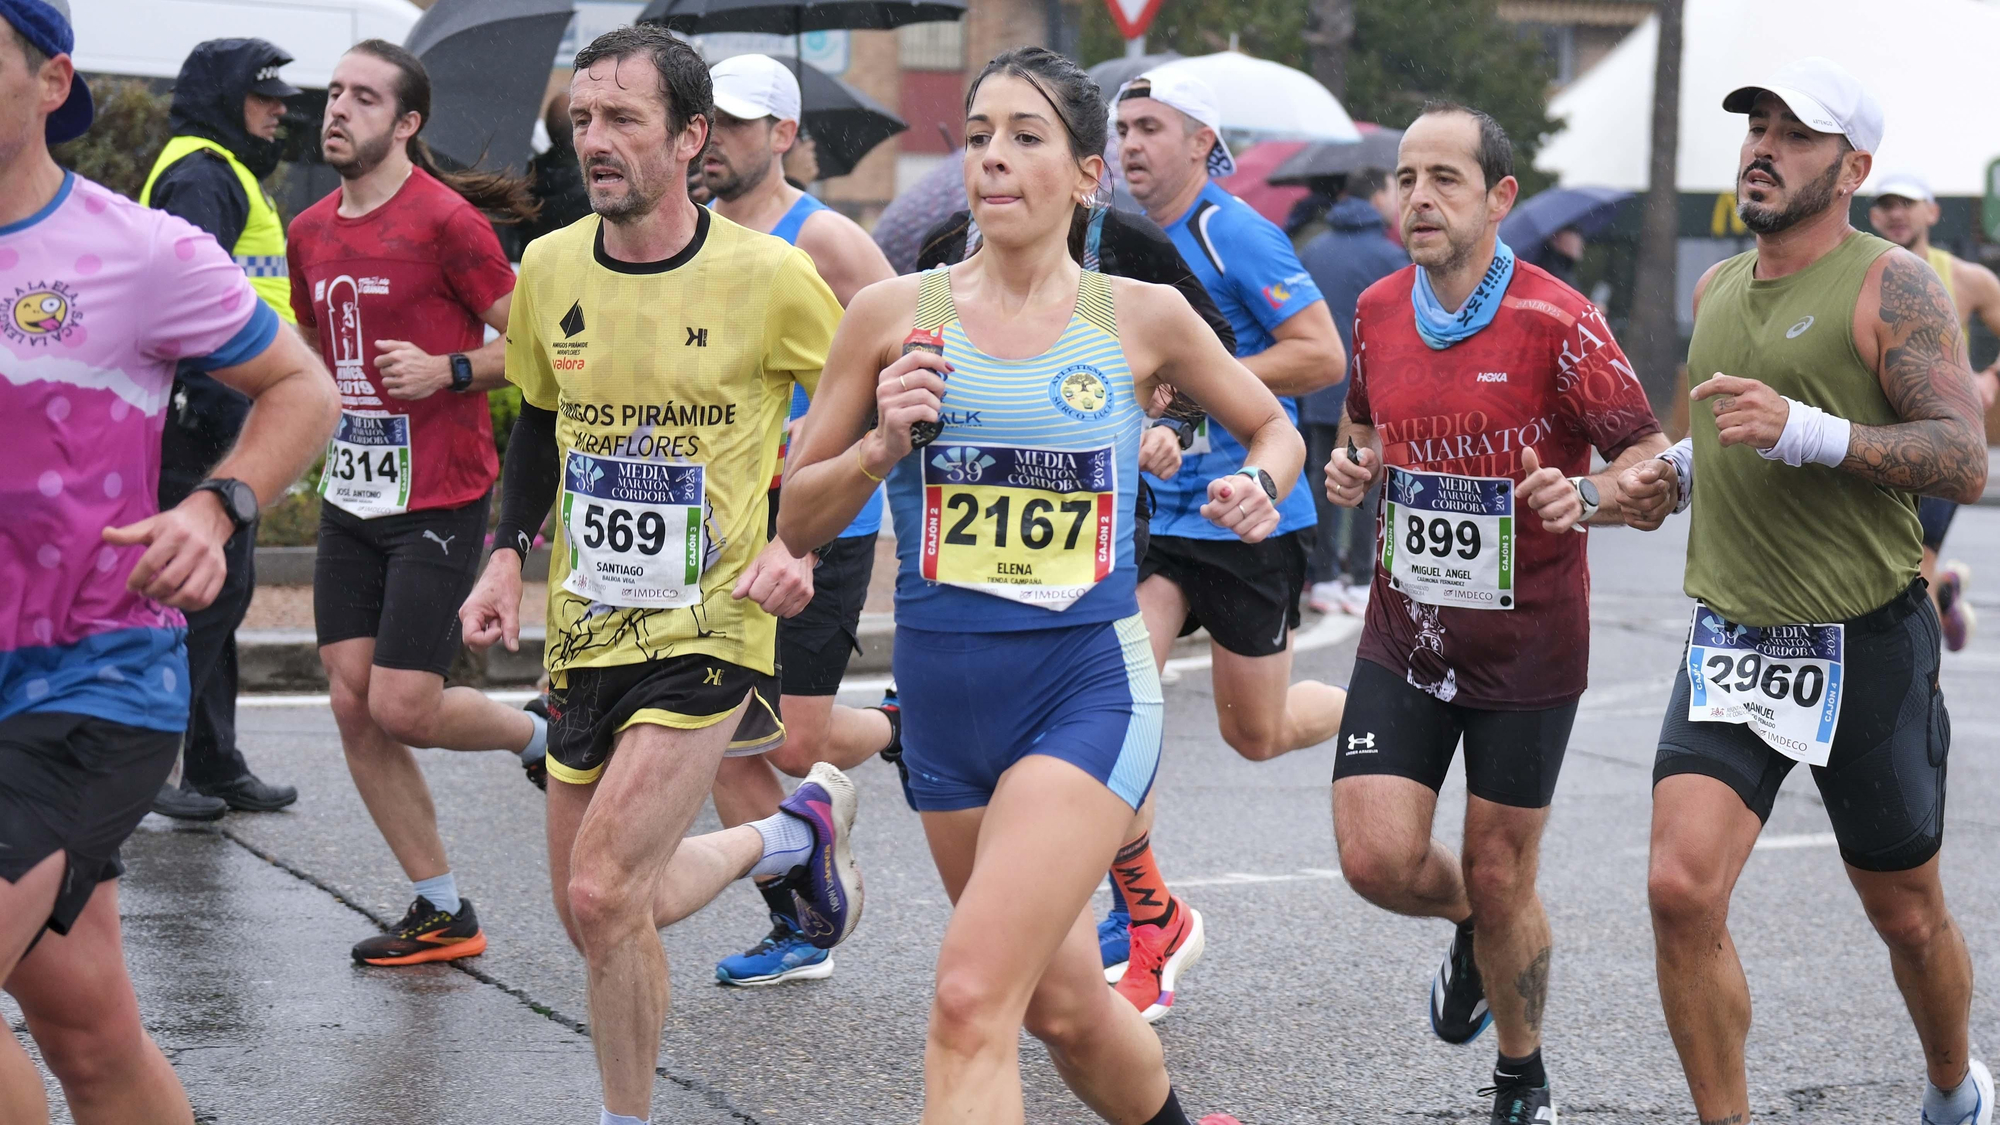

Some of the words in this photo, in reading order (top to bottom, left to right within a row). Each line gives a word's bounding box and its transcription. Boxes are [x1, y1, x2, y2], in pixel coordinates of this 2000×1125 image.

[552, 341, 568, 349] AMIGOS
[552, 356, 586, 371] valora
[1476, 371, 1508, 383] HOKA
[337, 380, 376, 395] 2019
[351, 416, 384, 429] MEDIA
[621, 400, 737, 427] PIRÁMIDE
[351, 427, 386, 436] MARATÓN
[1387, 410, 1489, 444] MEDIO
[348, 434, 390, 445] CÓRDOBA
[573, 430, 701, 458] MIRAFLORES
[1408, 413, 1557, 464] MARATÓN
[331, 445, 398, 484] 2314
[1014, 449, 1078, 470] MEDIA
[1093, 451, 1106, 487] 2025
[576, 468, 595, 493] 39
[617, 462, 670, 481] MEDIA
[945, 460, 984, 483] 39
[1014, 464, 1078, 480] MARATÓN
[617, 477, 670, 491] MARATÓN
[684, 468, 696, 500] 2025
[1007, 472, 1083, 492] CÓRDOBA
[1438, 476, 1482, 494] MEDIA
[336, 487, 351, 497] JOSÉ
[352, 489, 382, 499] ANTONIO
[611, 487, 675, 503] CÓRDOBA
[1437, 490, 1482, 503] MARATÓN
[930, 506, 939, 516] 2
[1431, 499, 1488, 513] CÓRDOBA
[944, 492, 1092, 550] 2167
[1101, 515, 1110, 524] 2
[583, 503, 666, 556] 569
[927, 518, 939, 556] CAJÓN
[1405, 514, 1482, 561] 899
[689, 533, 697, 567] CAJÓN
[1098, 525, 1109, 563] CAJÓN
[1386, 529, 1394, 557] CAJÓN
[596, 561, 644, 577] SANTIAGO
[996, 562, 1033, 575] ELENA
[1411, 564, 1442, 577] MIGUEL
[1444, 568, 1472, 580] ANGEL
[601, 575, 621, 583] BALBOA
[622, 577, 636, 585] VEGA
[986, 576, 1009, 585] TIENDA
[1010, 576, 1043, 586] CAMPAÑA
[634, 588, 679, 598] IMDECO
[1034, 588, 1086, 600] IMDECO
[1454, 590, 1494, 601] IMDECO
[1755, 643, 1818, 657] CÓRDOBA
[1826, 627, 1836, 656] 2025
[1706, 653, 1824, 708] 2960
[1742, 702, 1775, 721] MANUEL
[1824, 690, 1837, 722] CAJÓN
[1831, 682, 1838, 690] 4
[1767, 732, 1808, 752] IMDECO
[823, 844, 835, 892] balance
[827, 889, 841, 913] new
